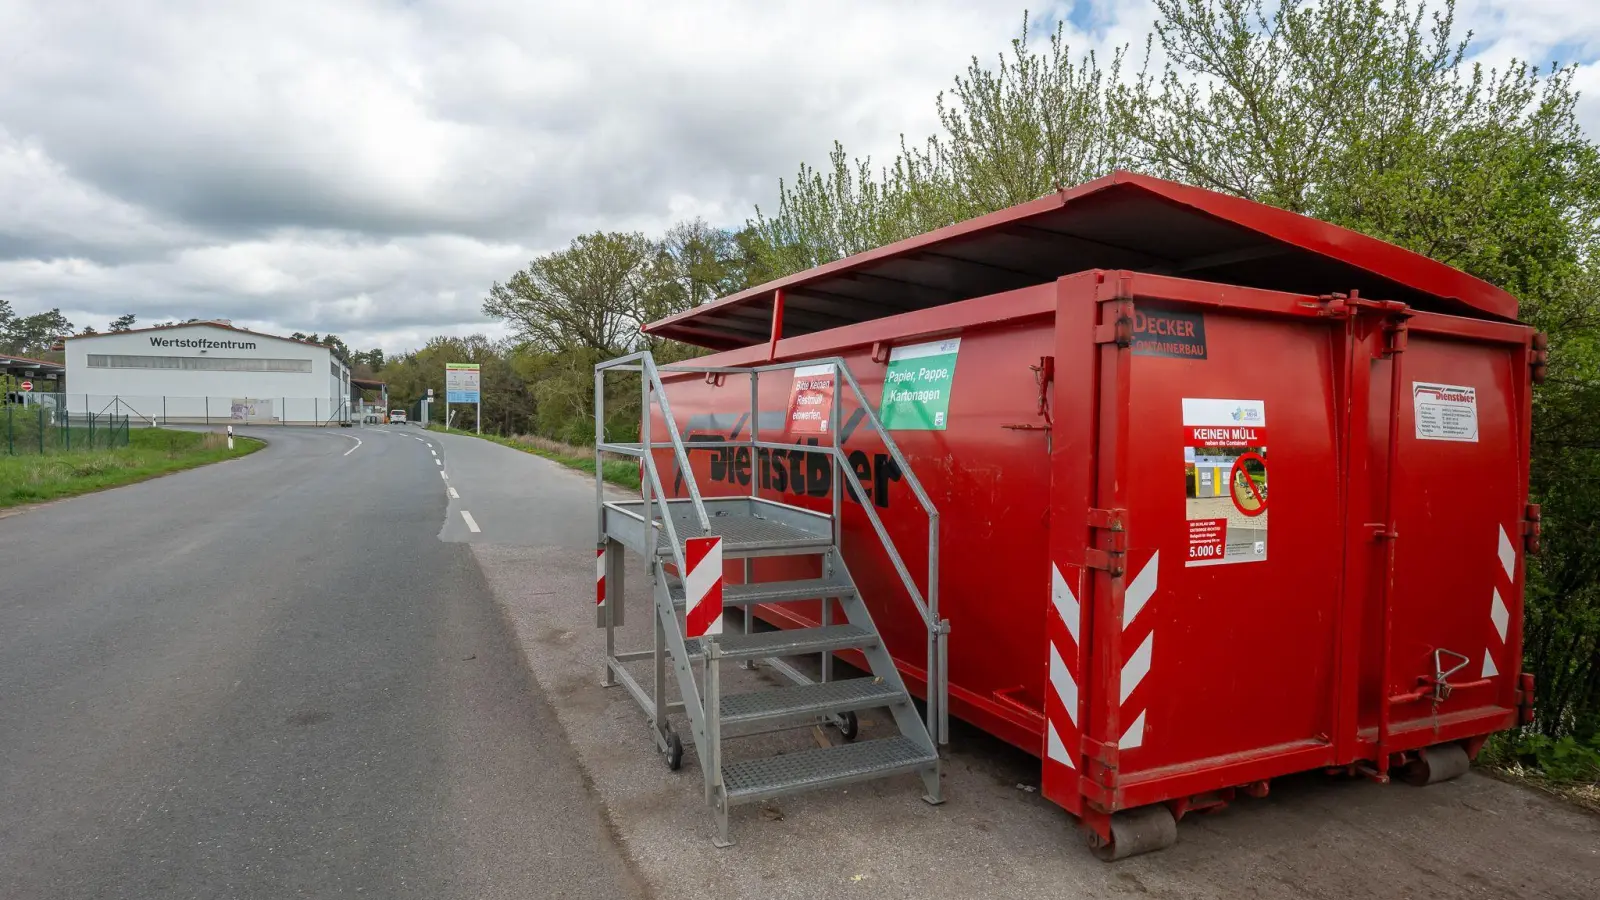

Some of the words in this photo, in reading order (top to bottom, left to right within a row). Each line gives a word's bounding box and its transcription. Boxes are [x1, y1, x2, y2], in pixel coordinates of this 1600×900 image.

[1133, 311, 1195, 337] DECKER
[150, 337, 256, 349] Wertstoffzentrum
[888, 369, 916, 385] Papier,
[918, 367, 949, 382] Pappe,
[796, 381, 809, 390] Bitte
[889, 389, 940, 403] Kartonagen
[1436, 391, 1474, 403] Dienstbier
[792, 409, 821, 420] einwerfen.
[1194, 428, 1230, 439] KEINEN
[1232, 427, 1257, 439] MÜLL
[709, 435, 903, 508] Dienstber
[1189, 545, 1214, 557] 5.000
[1216, 544, 1222, 555] €
